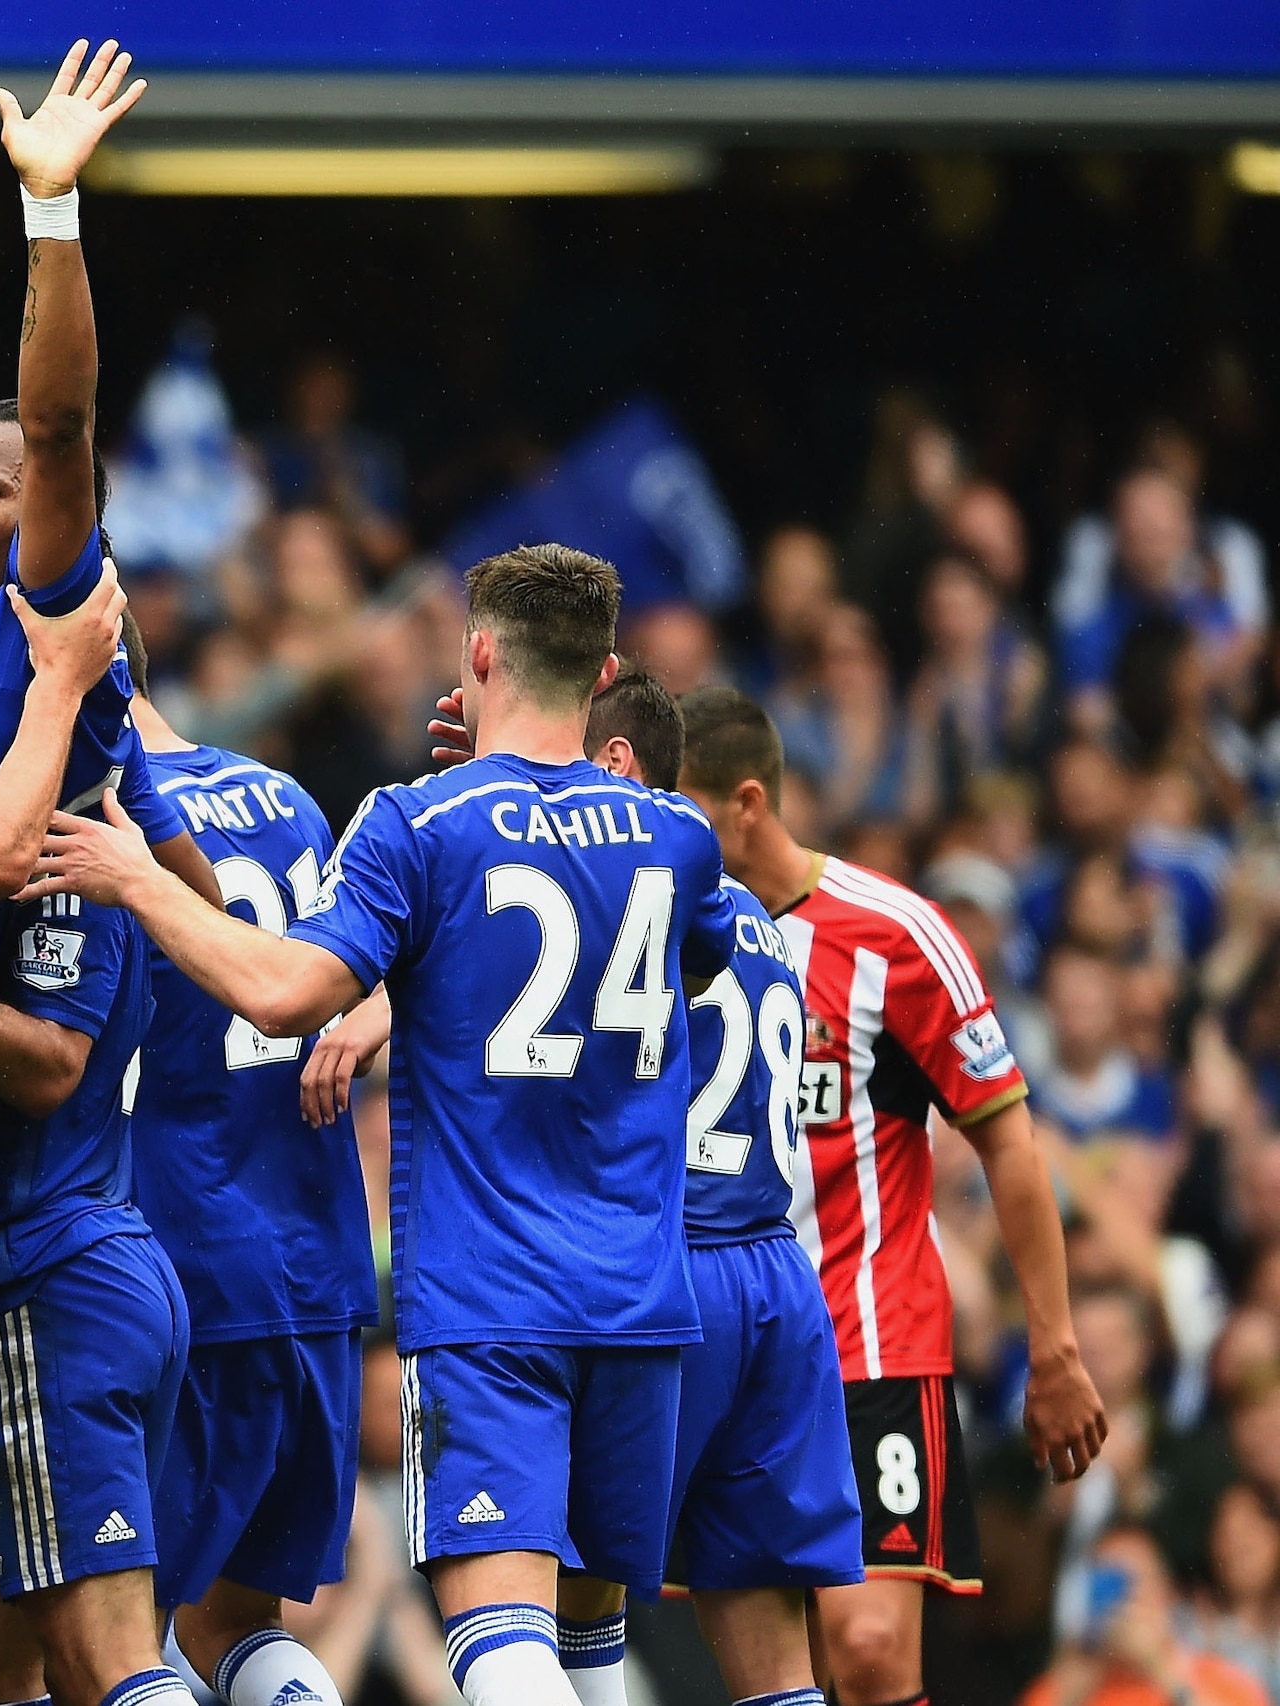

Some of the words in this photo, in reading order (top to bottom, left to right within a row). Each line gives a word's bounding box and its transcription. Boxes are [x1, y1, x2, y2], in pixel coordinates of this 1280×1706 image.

[177, 779, 295, 833] MATIC
[490, 801, 653, 848] CAHILL
[21, 961, 63, 975] BARCLAYS
[484, 864, 674, 1080] 24
[686, 965, 804, 1189] 28
[876, 1432, 921, 1515] 8
[94, 1527, 137, 1544] adidas
[457, 1509, 506, 1524] adidas
